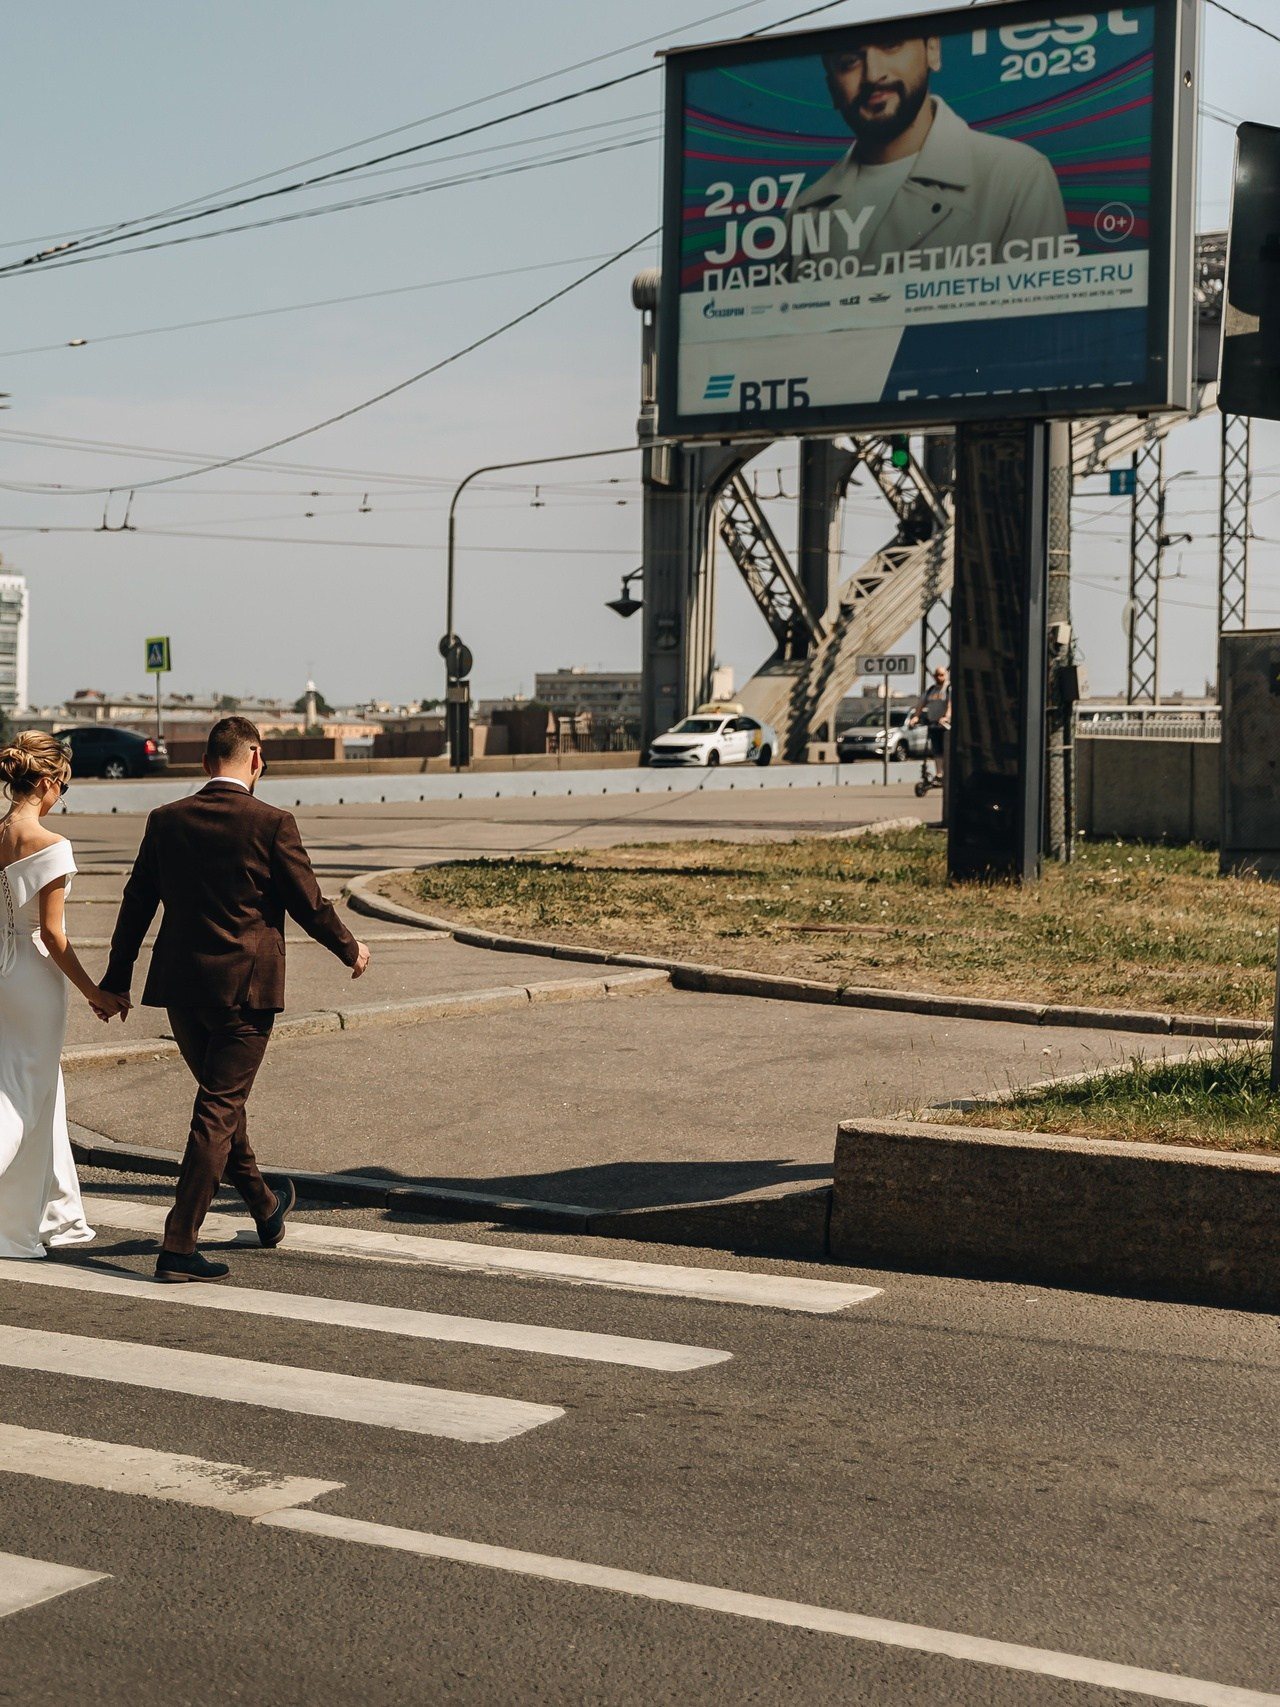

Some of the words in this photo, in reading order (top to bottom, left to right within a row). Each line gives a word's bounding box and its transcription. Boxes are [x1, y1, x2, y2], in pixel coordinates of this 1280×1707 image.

[1000, 44, 1097, 82] 2023
[704, 172, 806, 217] 2.07
[704, 205, 875, 264] JONY
[1103, 213, 1127, 232] 0+
[703, 262, 790, 292] ПАРК
[798, 242, 992, 282] 300-ЛЕТИЯ
[1002, 234, 1081, 264] СПБ
[905, 277, 1000, 300] БИЛЕТЫ
[1008, 263, 1133, 290] VKFEST.RU
[740, 377, 810, 412] ВТБ
[864, 658, 908, 672] СТОП
